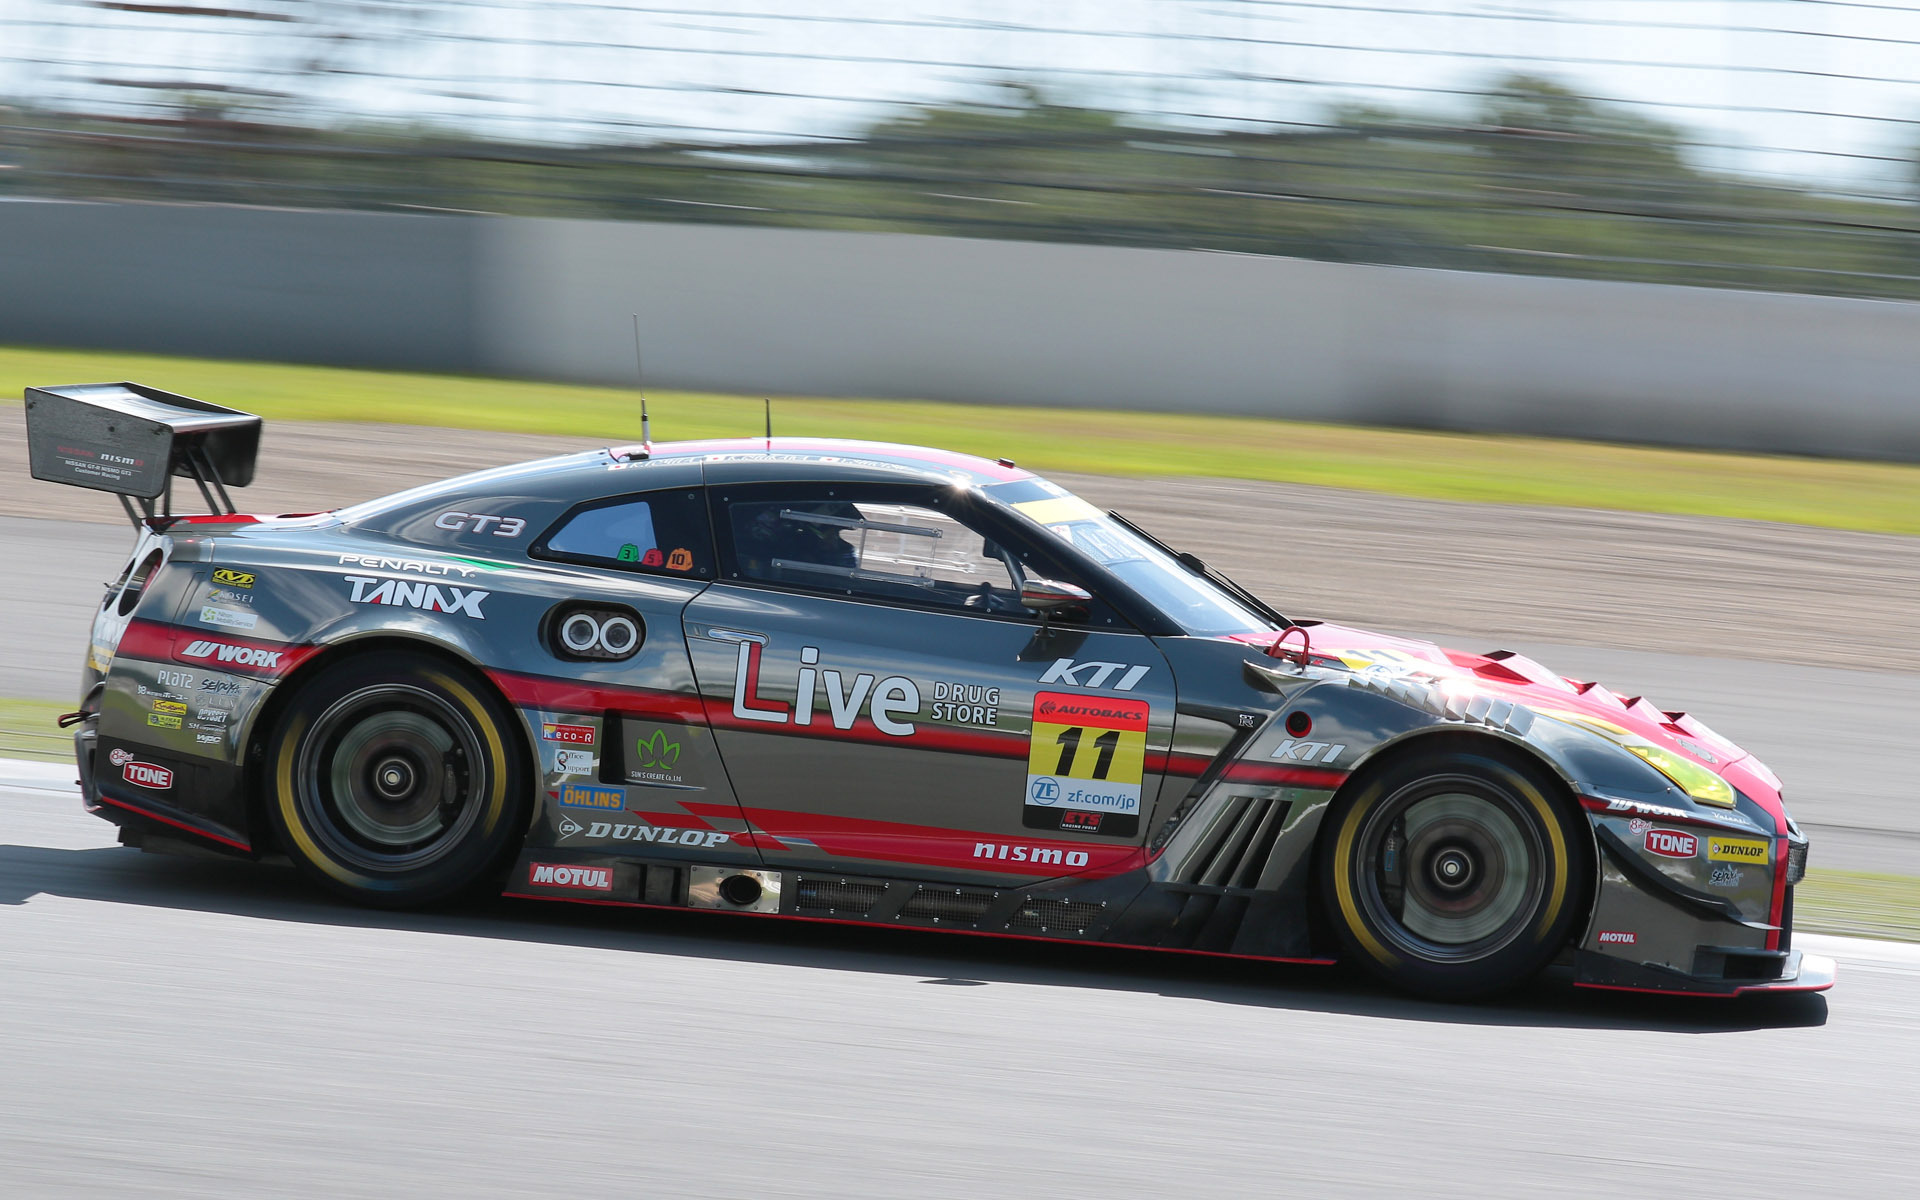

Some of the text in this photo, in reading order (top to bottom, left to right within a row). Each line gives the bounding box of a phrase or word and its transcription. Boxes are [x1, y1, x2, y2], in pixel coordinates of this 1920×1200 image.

[100, 453, 144, 466] nismo
[434, 511, 528, 538] GT3
[623, 549, 631, 560] 3
[647, 553, 656, 564] 5
[671, 553, 686, 566] 10
[338, 554, 474, 578] PENALTY
[343, 576, 491, 620] TANAX
[217, 644, 284, 668] WORK
[1037, 657, 1152, 692] KTI
[732, 640, 922, 737] Live
[933, 681, 1001, 706] DRUG
[931, 701, 998, 726] STORE
[1057, 704, 1143, 721] AUTOBACS
[556, 731, 593, 743] eco-R
[557, 751, 584, 762] Office
[1055, 727, 1121, 780] 11
[1270, 739, 1347, 763] KTI
[128, 764, 169, 786] TONE
[557, 759, 590, 773] Support
[646, 772, 665, 781] CREATE
[564, 785, 622, 809] ÖHLINS
[1033, 780, 1059, 801] ZF
[1067, 789, 1135, 810] zf.com/jp
[1064, 811, 1102, 826] ETS
[1633, 801, 1688, 818] WORK
[585, 821, 730, 847] DUNLOP
[1650, 833, 1694, 854] TONE
[973, 842, 1088, 867] nismo
[1722, 845, 1764, 857] DUNLOP
[532, 865, 609, 888] MOTUL
[1600, 932, 1635, 943] MOTUL
